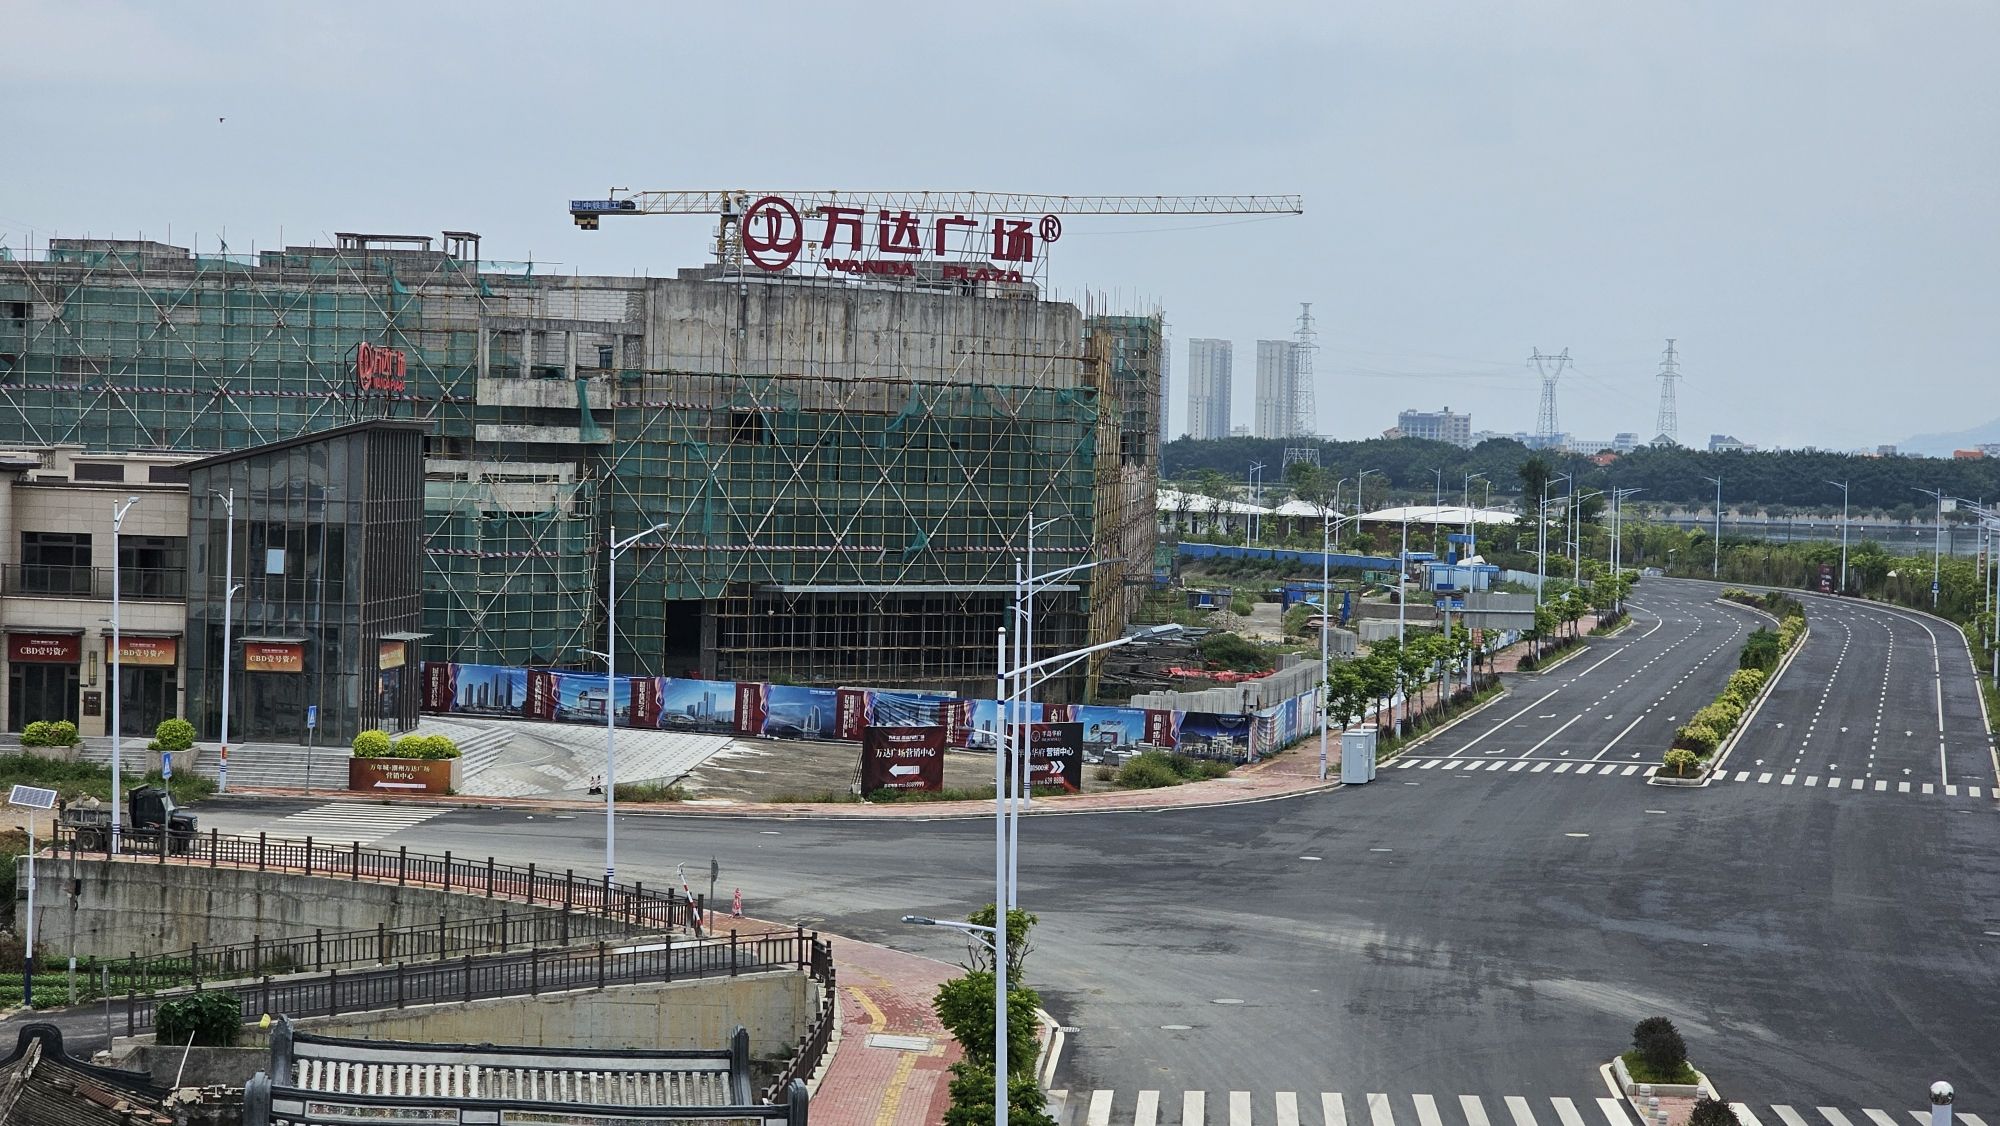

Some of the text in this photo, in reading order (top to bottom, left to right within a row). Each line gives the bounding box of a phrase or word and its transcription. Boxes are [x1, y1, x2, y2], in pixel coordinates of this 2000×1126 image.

[817, 206, 1033, 263] 万达广场
[823, 257, 1023, 284] WANDA PLAZA
[20, 646, 69, 656] CBD壹号资产
[249, 655, 297, 663] CBD壹号资产
[875, 747, 936, 758] 万达广场营销中心
[1046, 747, 1074, 757] 营销中心
[385, 771, 414, 780] 营销中心
